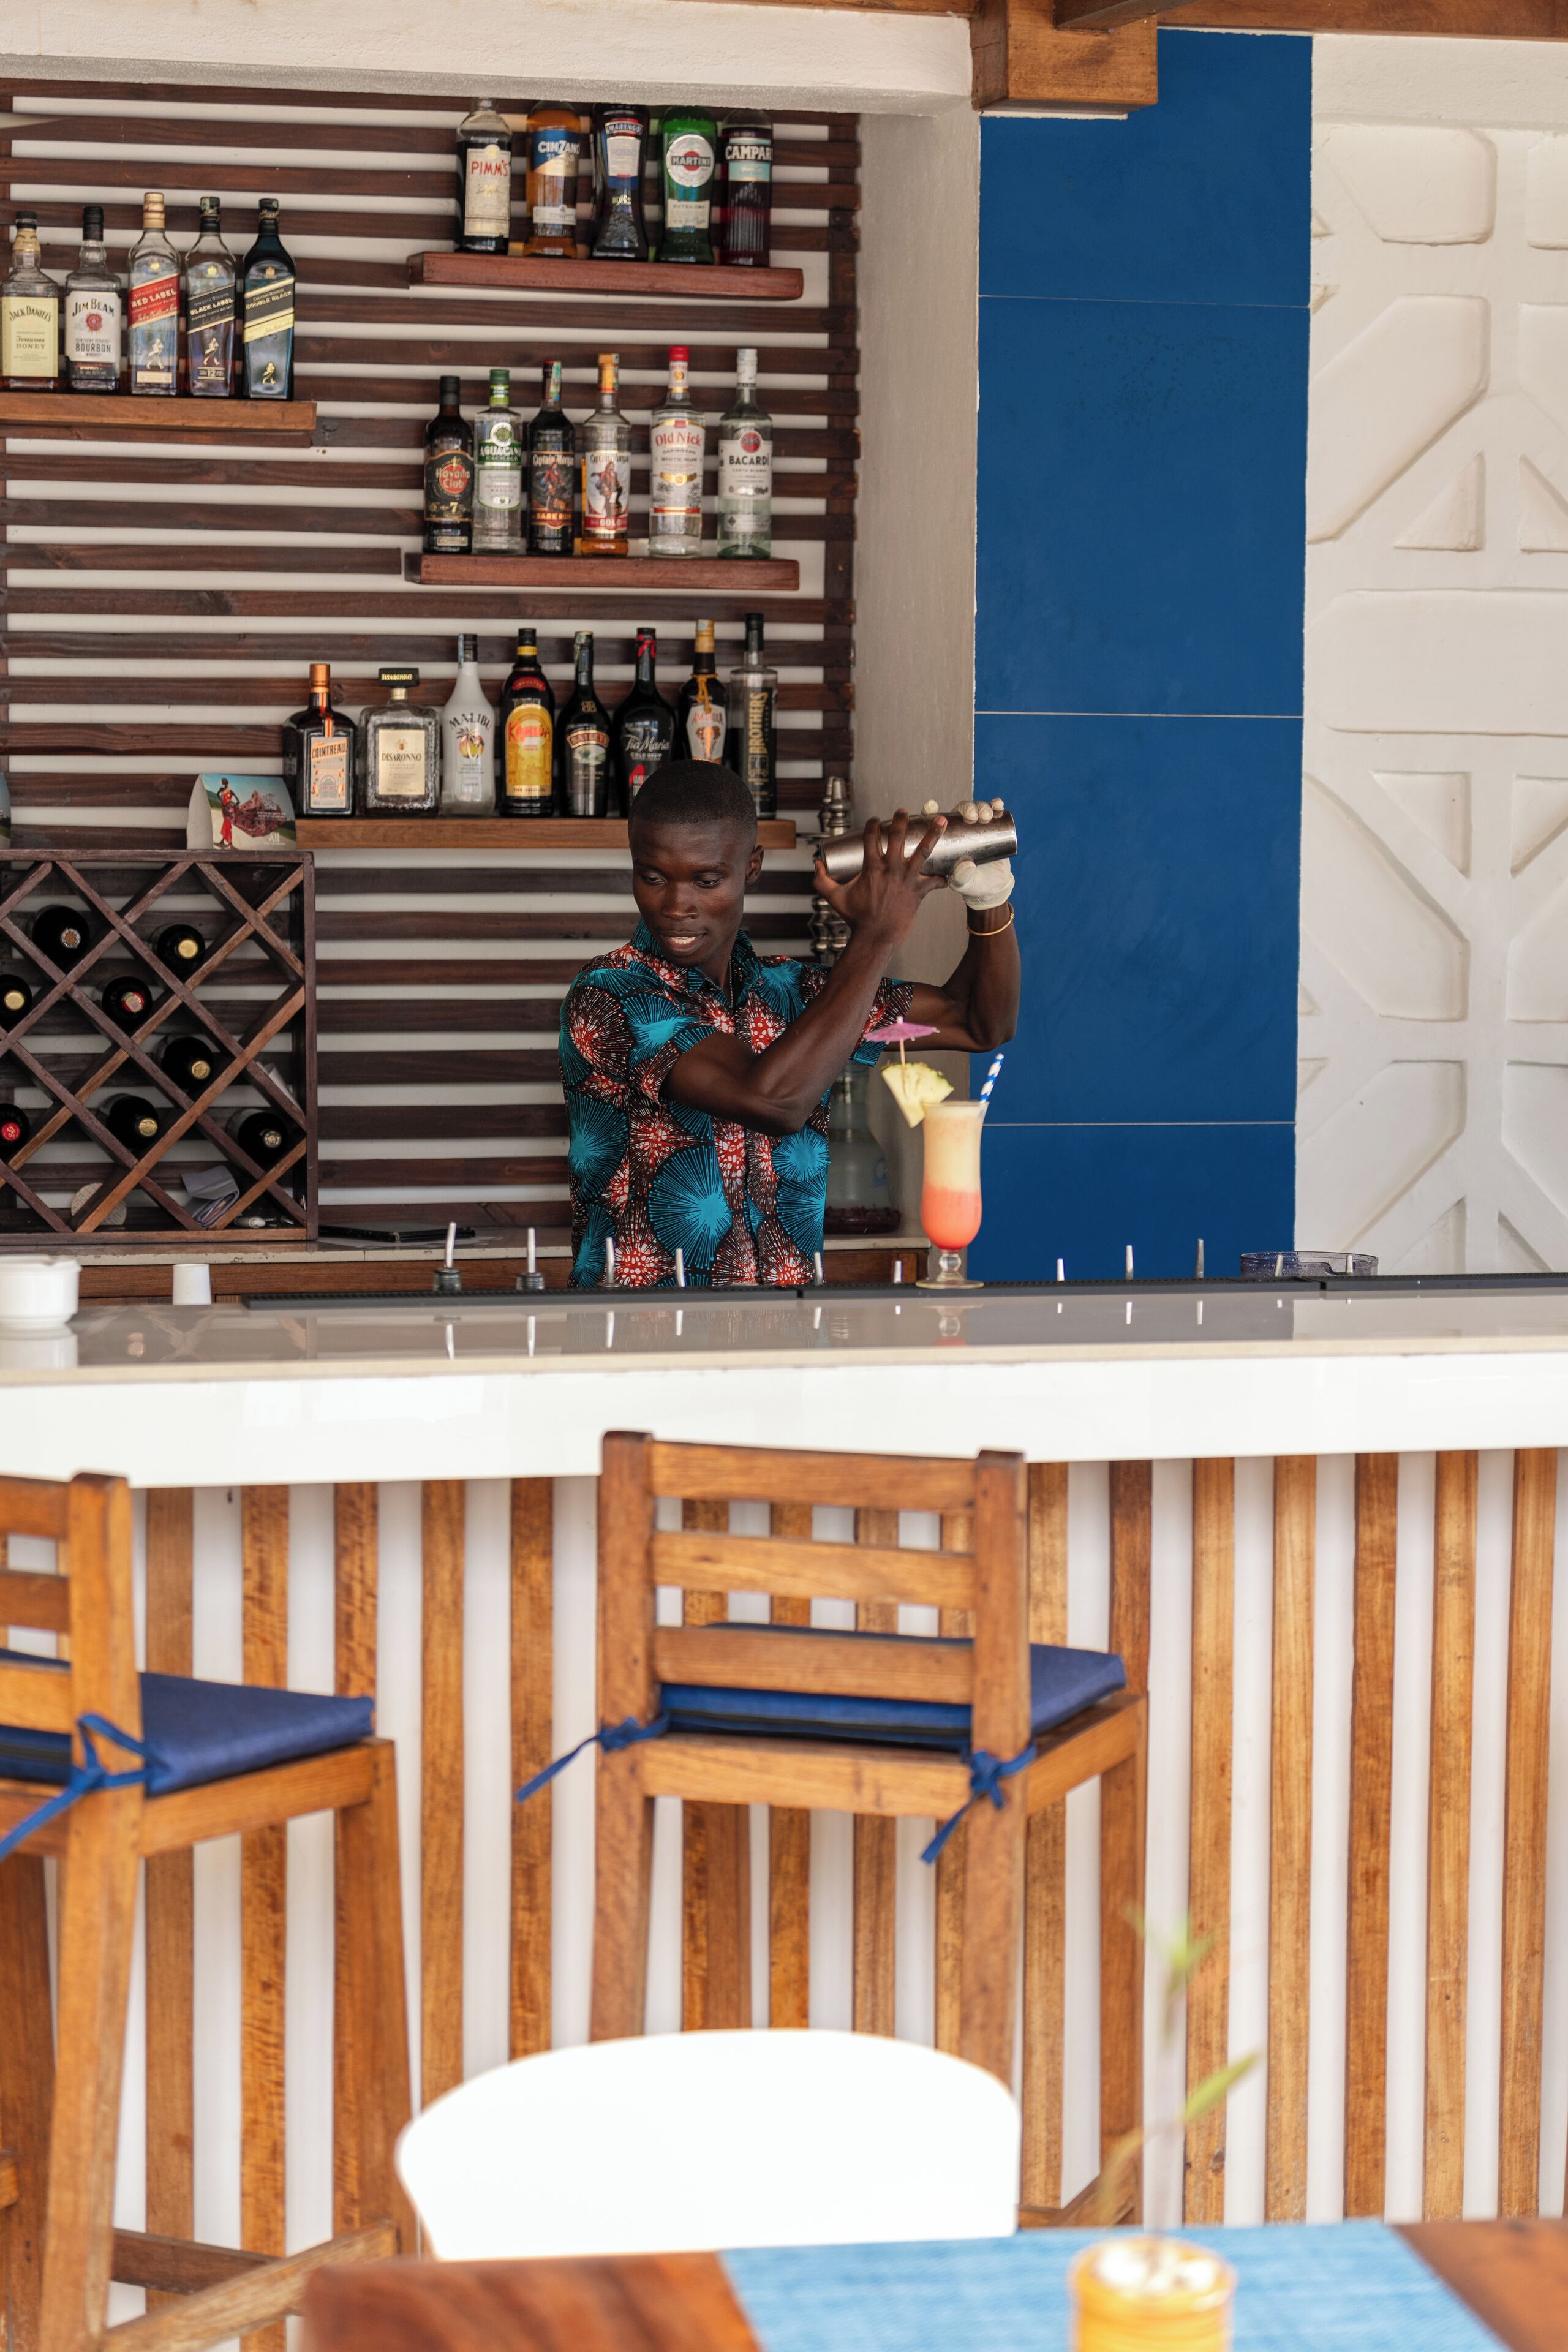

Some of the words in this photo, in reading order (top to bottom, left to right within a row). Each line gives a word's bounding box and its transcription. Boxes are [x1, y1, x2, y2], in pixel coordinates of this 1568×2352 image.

[471, 160, 509, 177] PIMM'S
[672, 156, 710, 166] MARTINI
[131, 296, 148, 308] RED
[149, 288, 177, 303] LABEL
[246, 298, 271, 310] DOUBLE
[271, 290, 293, 302] BLACK
[72, 301, 89, 317] JIM
[91, 298, 114, 317] BEAM
[190, 305, 212, 316] BLACK
[213, 297, 234, 309] LABEL
[75, 343, 111, 353] BOURBON
[208, 369, 216, 377] 12
[655, 432, 674, 447] Old
[677, 431, 702, 447] Nick
[435, 467, 470, 479] Havana
[443, 478, 464, 489] Club
[450, 502, 458, 513] 7
[600, 518, 622, 527] GOLD
[449, 712, 491, 731] MALIBU
[748, 692, 769, 754] BROTHERS
[311, 741, 347, 760] COINTREAU
[623, 734, 641, 752] Tia
[636, 734, 670, 753] Maria
[382, 753, 421, 762] DISARONNO
